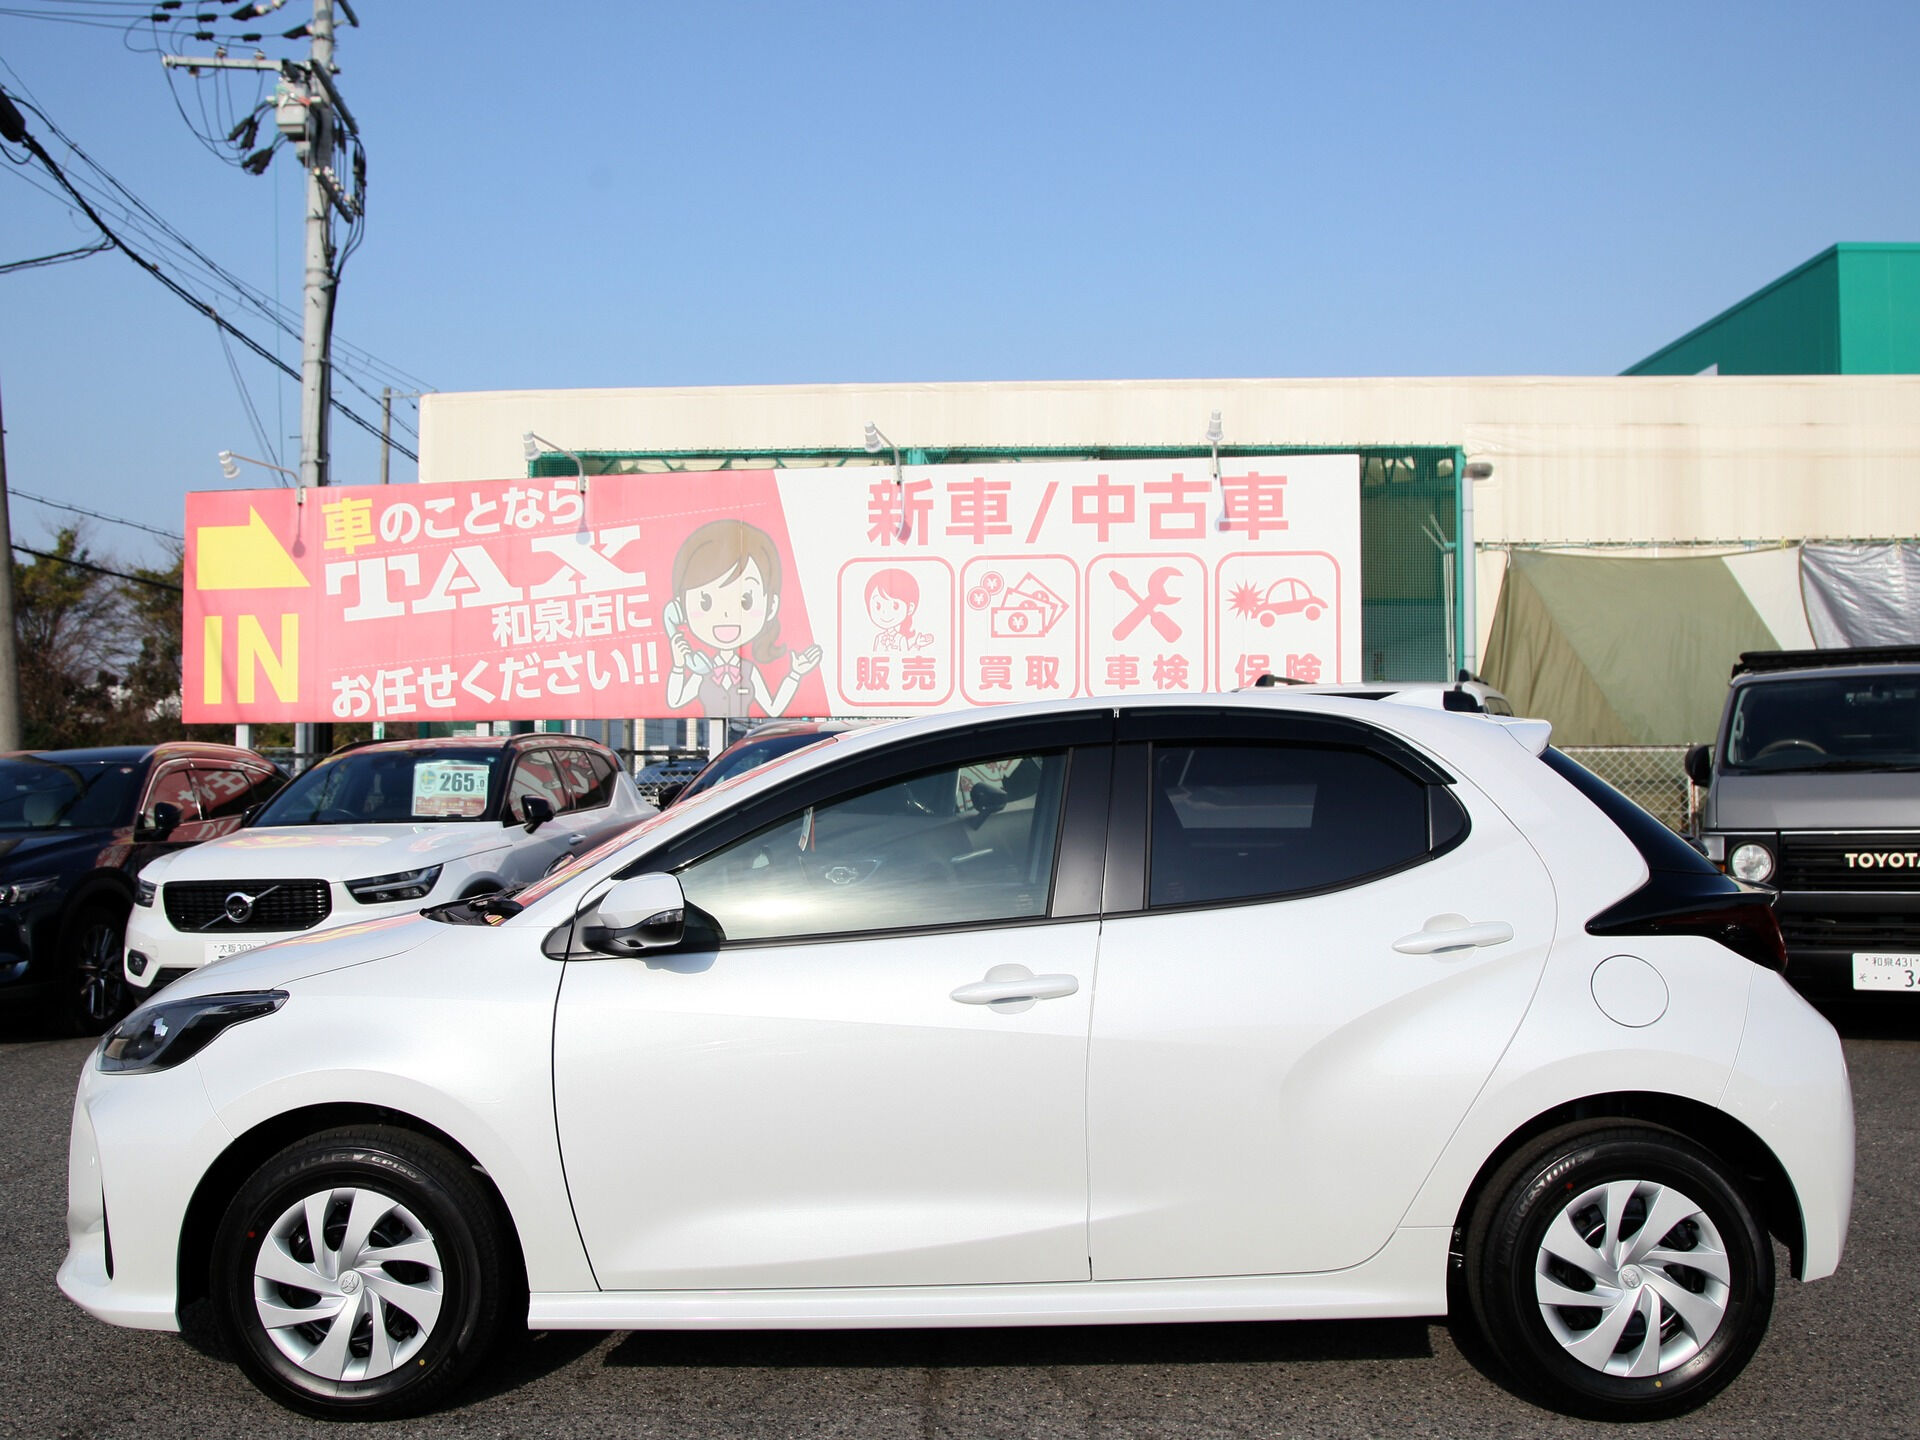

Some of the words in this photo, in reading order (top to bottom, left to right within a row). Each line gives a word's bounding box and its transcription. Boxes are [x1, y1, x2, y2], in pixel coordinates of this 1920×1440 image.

[321, 480, 584, 554] 車のことなら
[867, 472, 1289, 546] 新車/中古車
[325, 525, 647, 622] TAX
[491, 592, 652, 647] 和泉店に
[203, 613, 299, 704] IN
[331, 641, 659, 718] お任せください!!
[856, 656, 937, 691] 販売
[979, 655, 1060, 690] 買取
[1104, 654, 1190, 690] 車検
[1235, 653, 1322, 688] 保険
[1845, 852, 1920, 868] TOYOT
